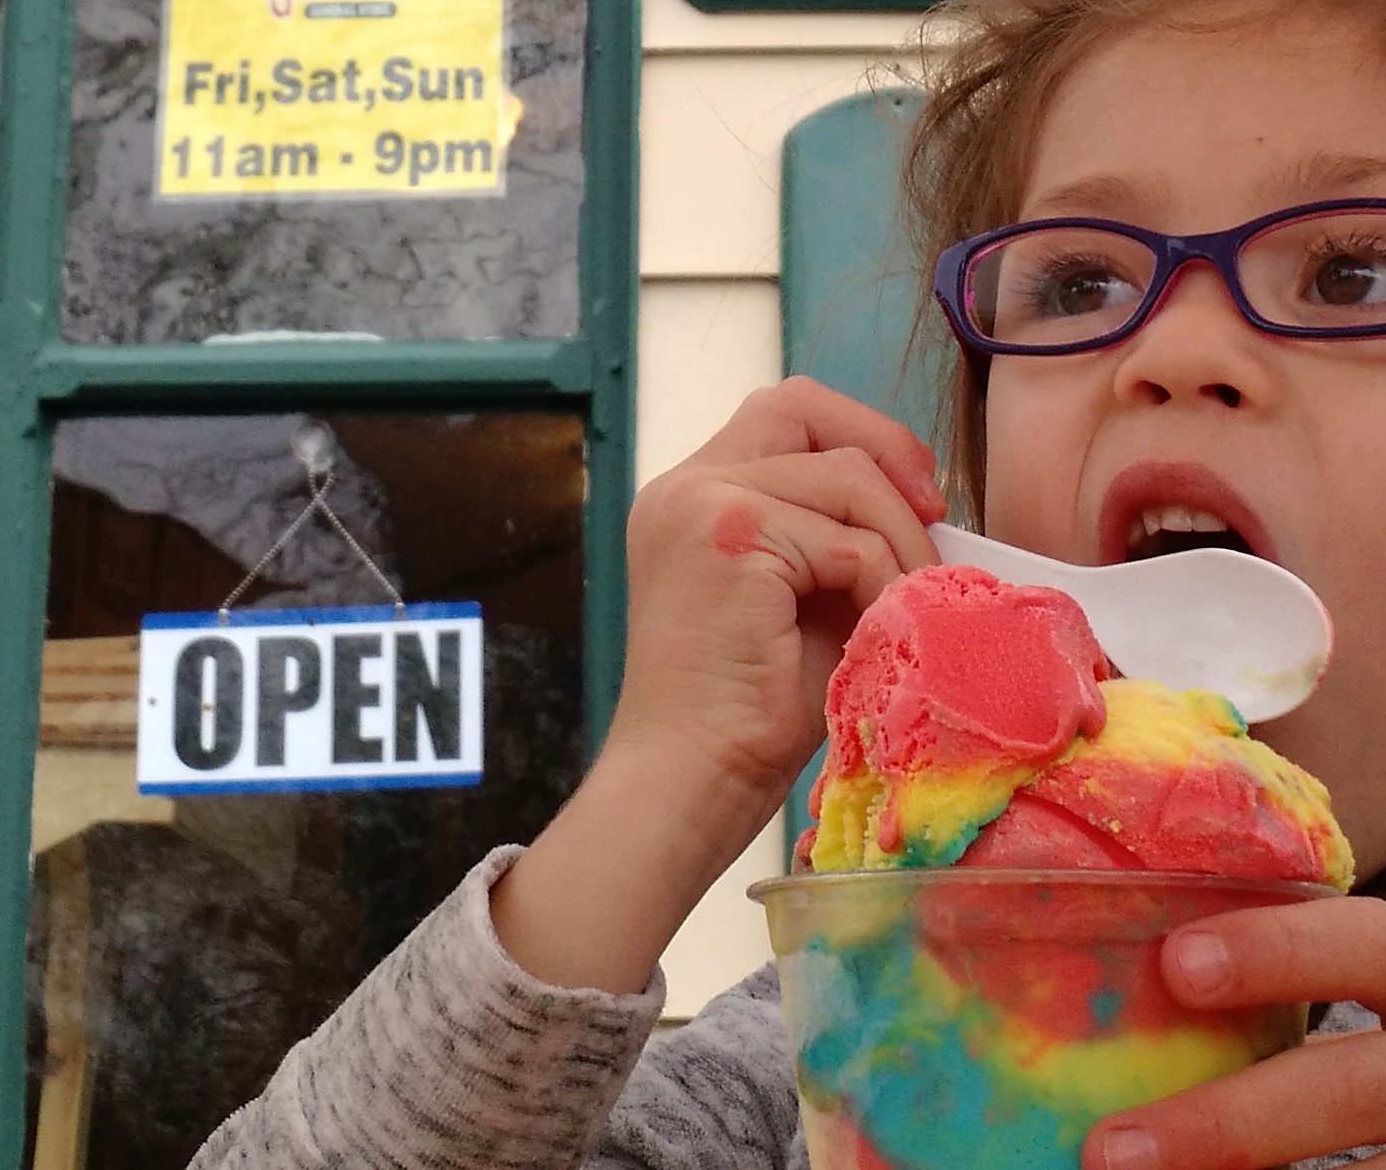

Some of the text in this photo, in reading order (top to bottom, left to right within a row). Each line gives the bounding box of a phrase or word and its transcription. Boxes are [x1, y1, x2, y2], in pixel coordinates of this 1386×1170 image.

[171, 134, 319, 179] 11am
[374, 129, 492, 187] 9pm
[172, 629, 462, 771] OPEN
